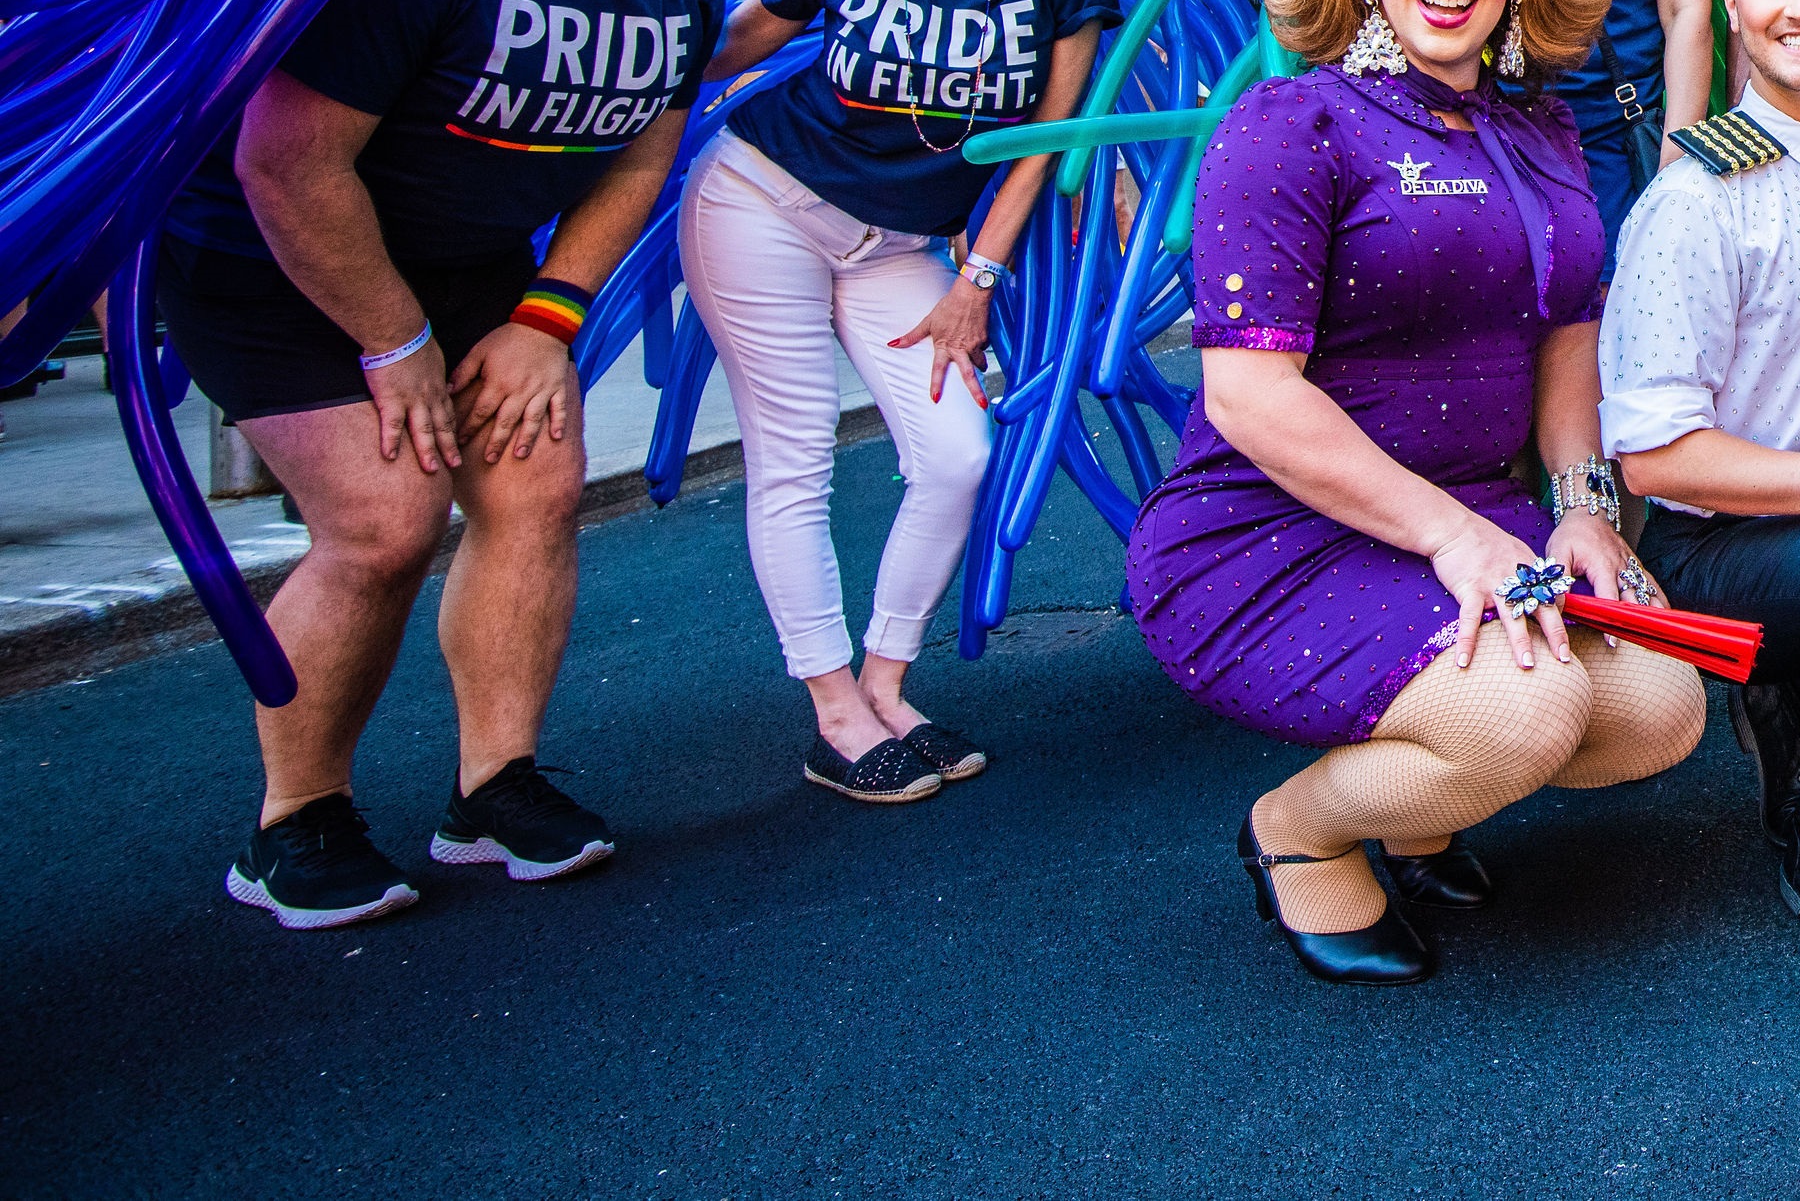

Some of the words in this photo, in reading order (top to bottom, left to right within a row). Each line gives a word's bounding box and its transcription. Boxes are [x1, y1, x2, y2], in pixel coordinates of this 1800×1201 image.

[456, 76, 532, 131] IN
[826, 38, 861, 92] IN
[868, 59, 1038, 110] FLIGHT.
